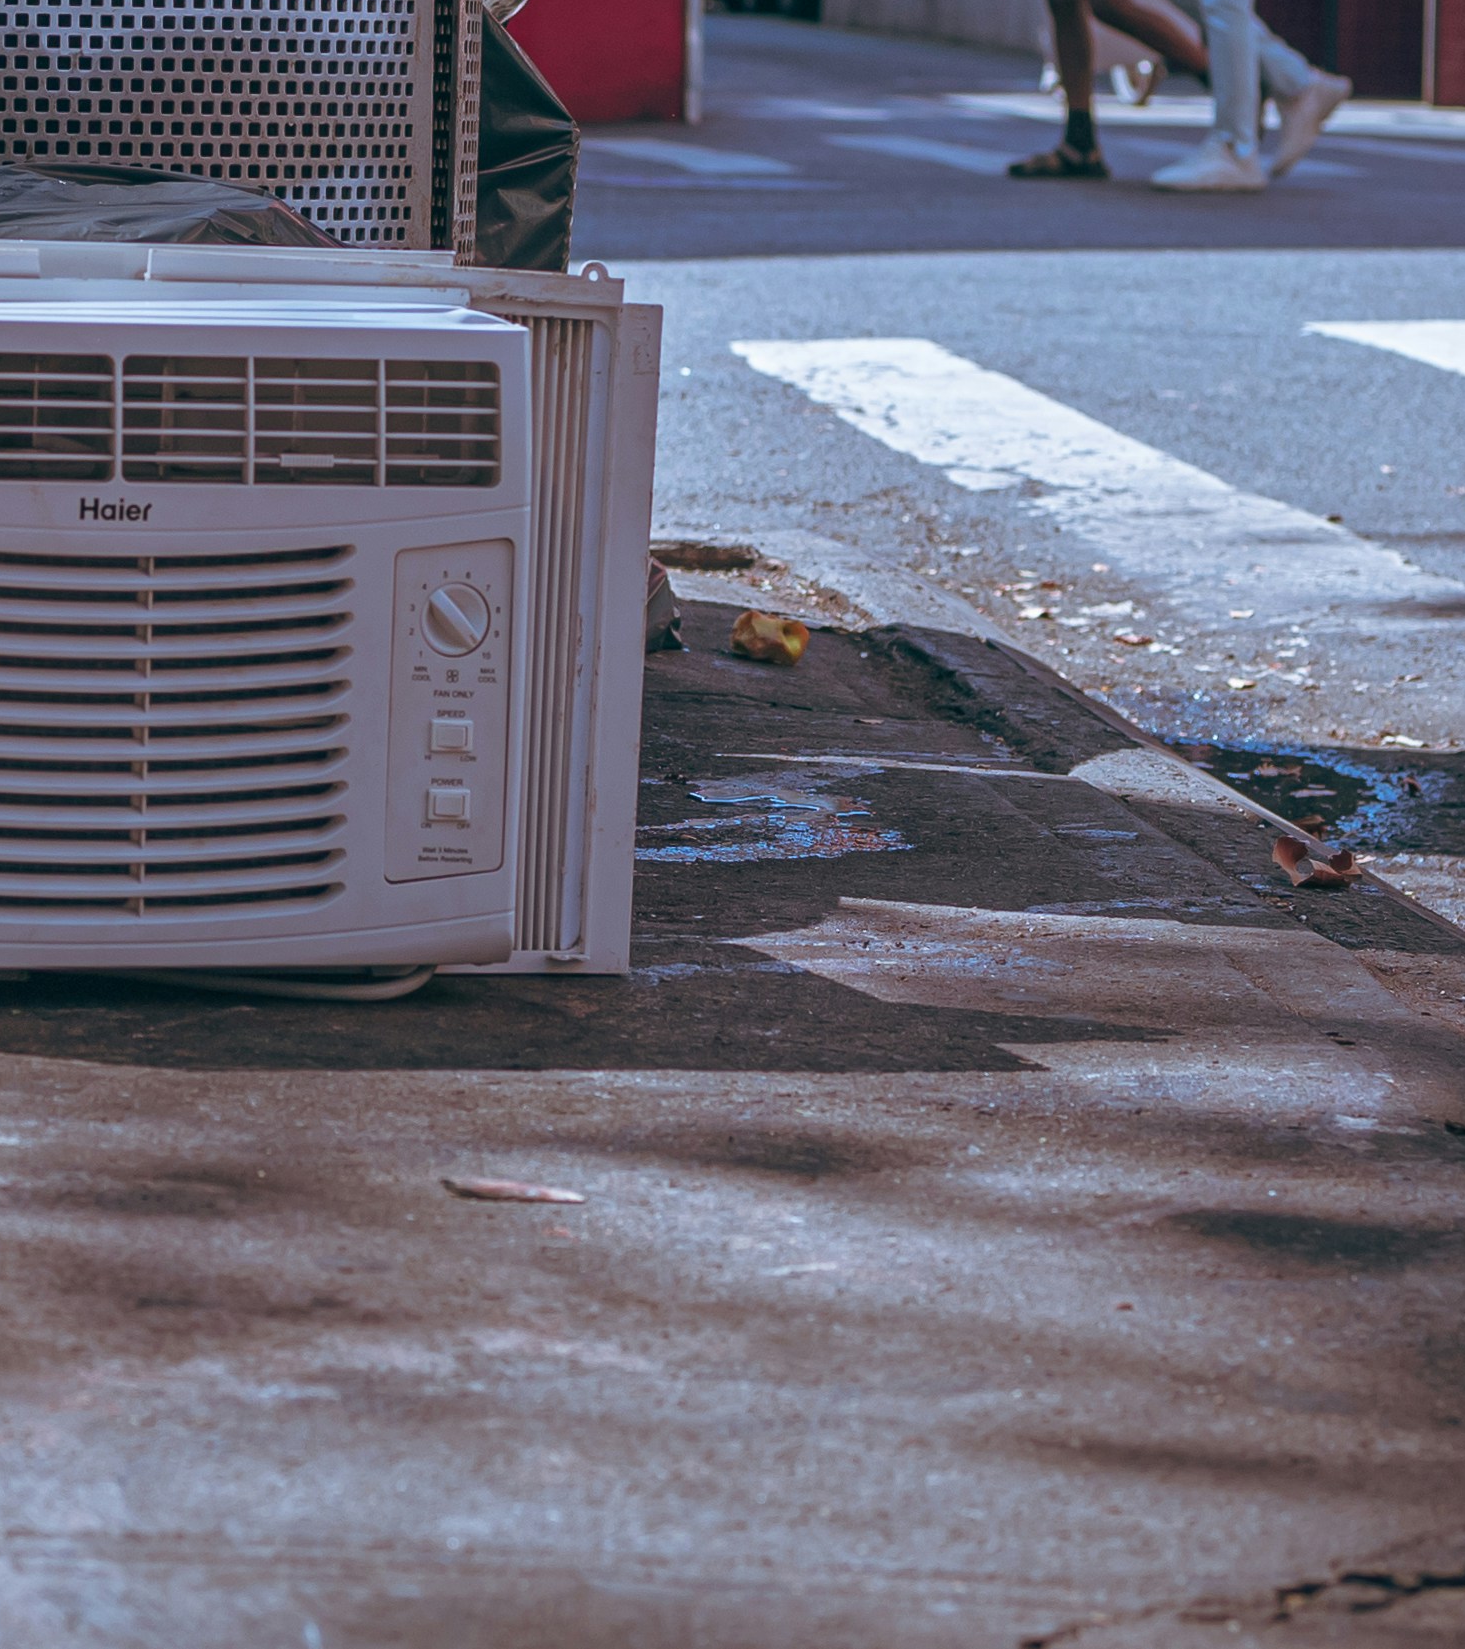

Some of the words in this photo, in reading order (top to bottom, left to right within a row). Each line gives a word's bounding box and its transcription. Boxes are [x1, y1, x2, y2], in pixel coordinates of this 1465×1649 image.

[79, 497, 153, 521] Haier
[413, 665, 428, 673] MIN
[479, 667, 496, 675] MAX
[412, 674, 431, 682] COOL
[478, 676, 497, 684] COOL
[433, 690, 450, 698] FAN
[452, 690, 475, 699] ONLY
[436, 710, 466, 718] SPEED
[430, 778, 464, 786] POWER
